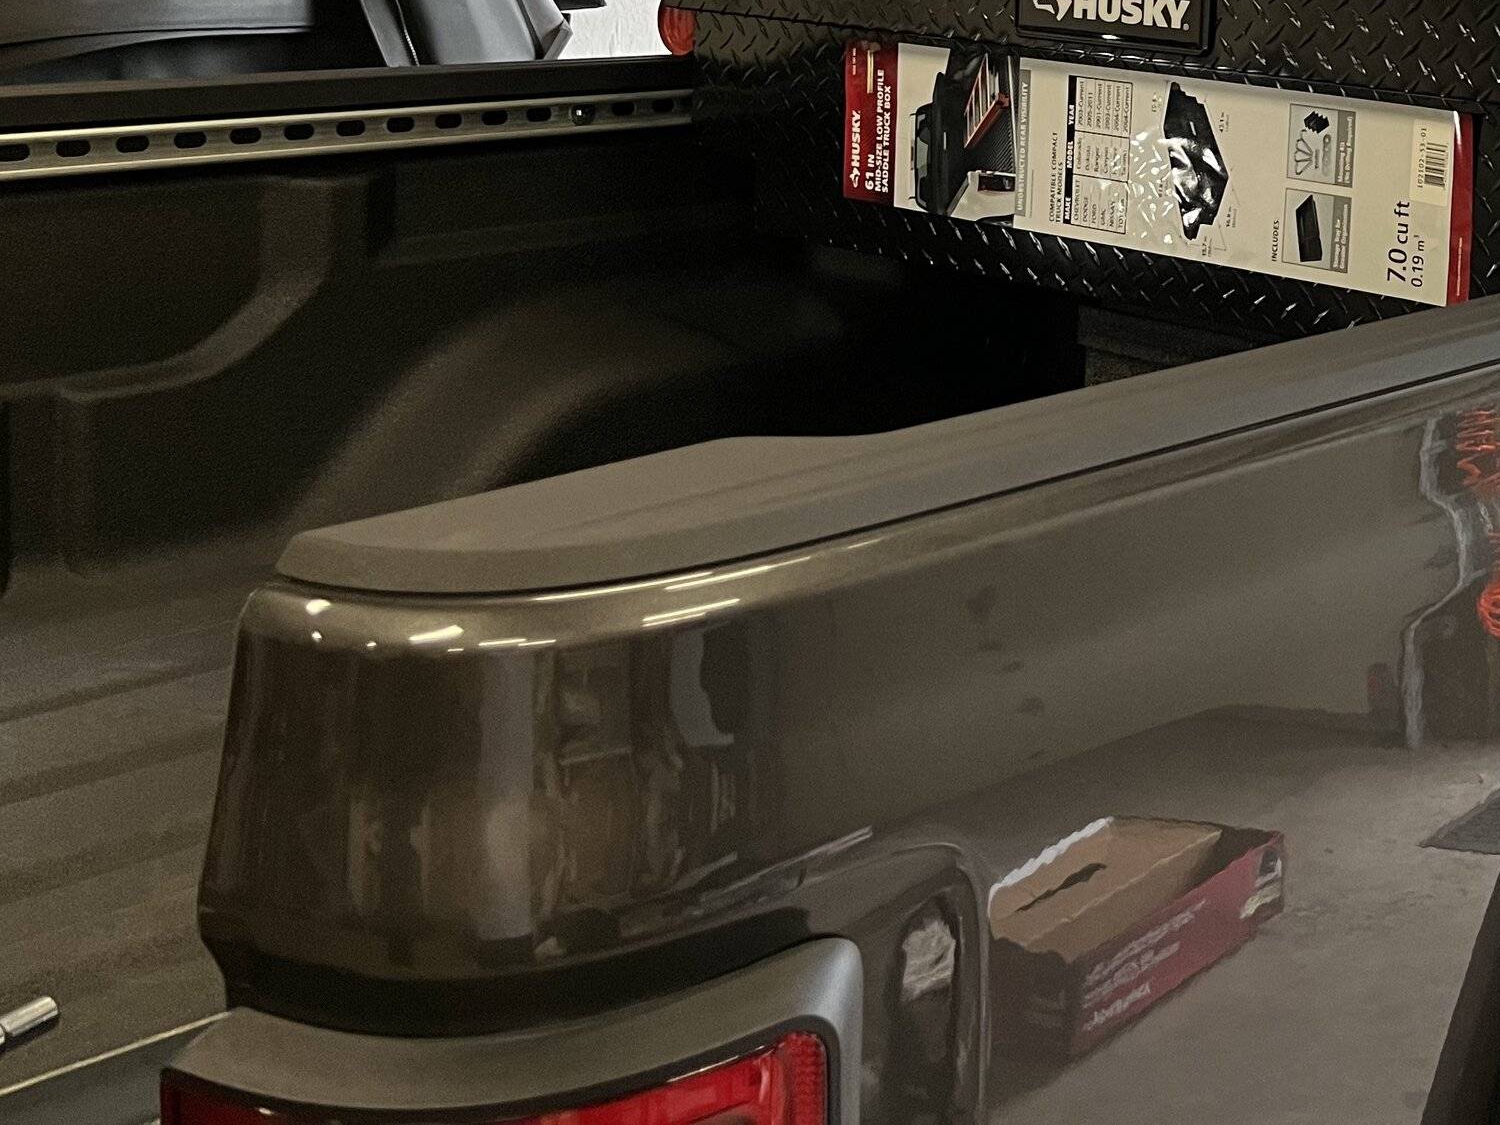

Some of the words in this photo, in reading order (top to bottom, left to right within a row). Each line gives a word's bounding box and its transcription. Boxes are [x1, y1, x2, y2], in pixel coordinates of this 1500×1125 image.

[852, 110, 860, 167] HUSKY
[867, 154, 874, 167] IN
[865, 172, 874, 190] 61
[1394, 200, 1410, 217] ft
[1397, 223, 1409, 244] cu
[1387, 249, 1407, 282] 7.0
[1411, 255, 1424, 287] 0.19
